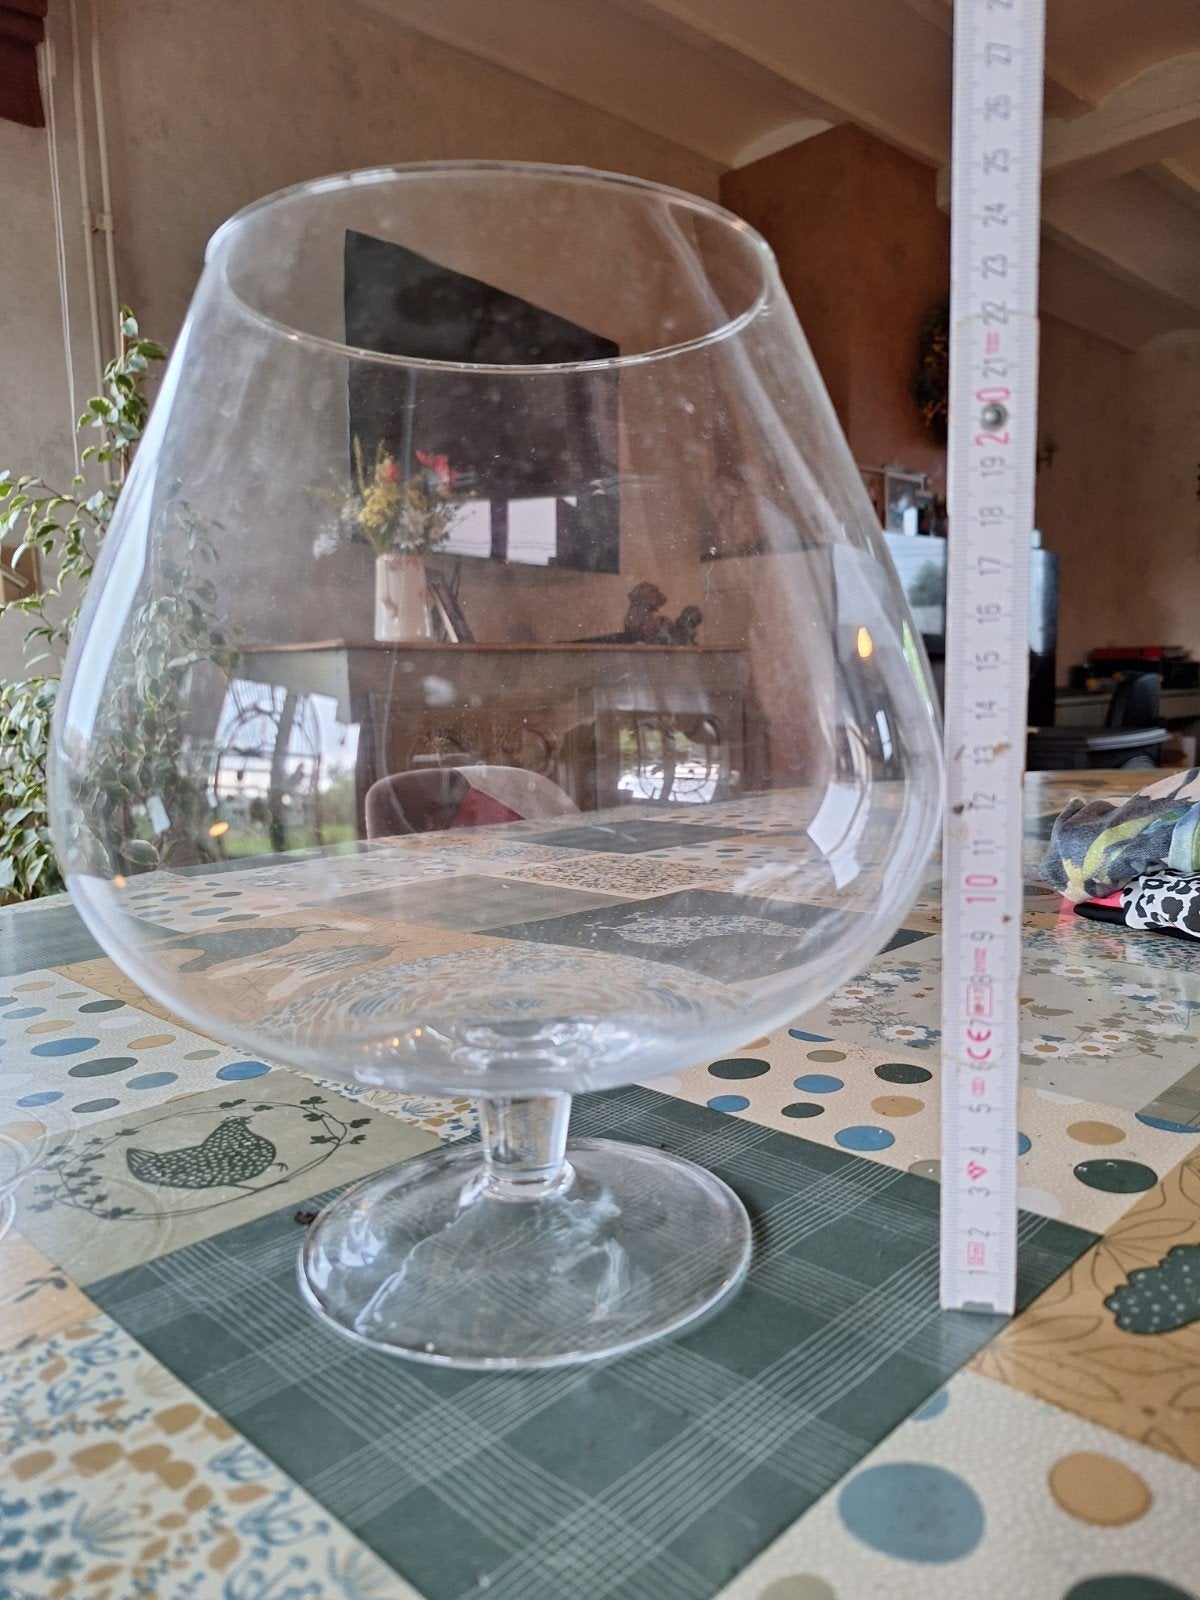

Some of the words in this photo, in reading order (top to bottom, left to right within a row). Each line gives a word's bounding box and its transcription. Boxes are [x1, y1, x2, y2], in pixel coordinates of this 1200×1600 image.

[984, 42, 1012, 67] 27
[982, 148, 1009, 176] 25
[982, 202, 1009, 228] 24
[981, 254, 1008, 280] 23
[981, 301, 1008, 327] 22
[982, 356, 1008, 380] 21
[974, 387, 1010, 447] 20
[979, 455, 1006, 478] 19
[979, 505, 1004, 528] 18
[977, 556, 1002, 577] 17
[976, 603, 1002, 625] 16
[975, 650, 999, 673] 15
[975, 701, 997, 721] 14
[974, 746, 996, 765] 13
[972, 792, 996, 811] 12
[972, 839, 994, 855] 11
[965, 874, 997, 904] 10
[970, 931, 994, 942] 9
[970, 974, 992, 985] 8
[969, 1018, 990, 1028] 7
[967, 1028, 991, 1060] CE
[969, 1103, 992, 1114] 5
[970, 1145, 989, 1156] 4
[968, 1187, 991, 1198] 3
[967, 1226, 991, 1238] 2
